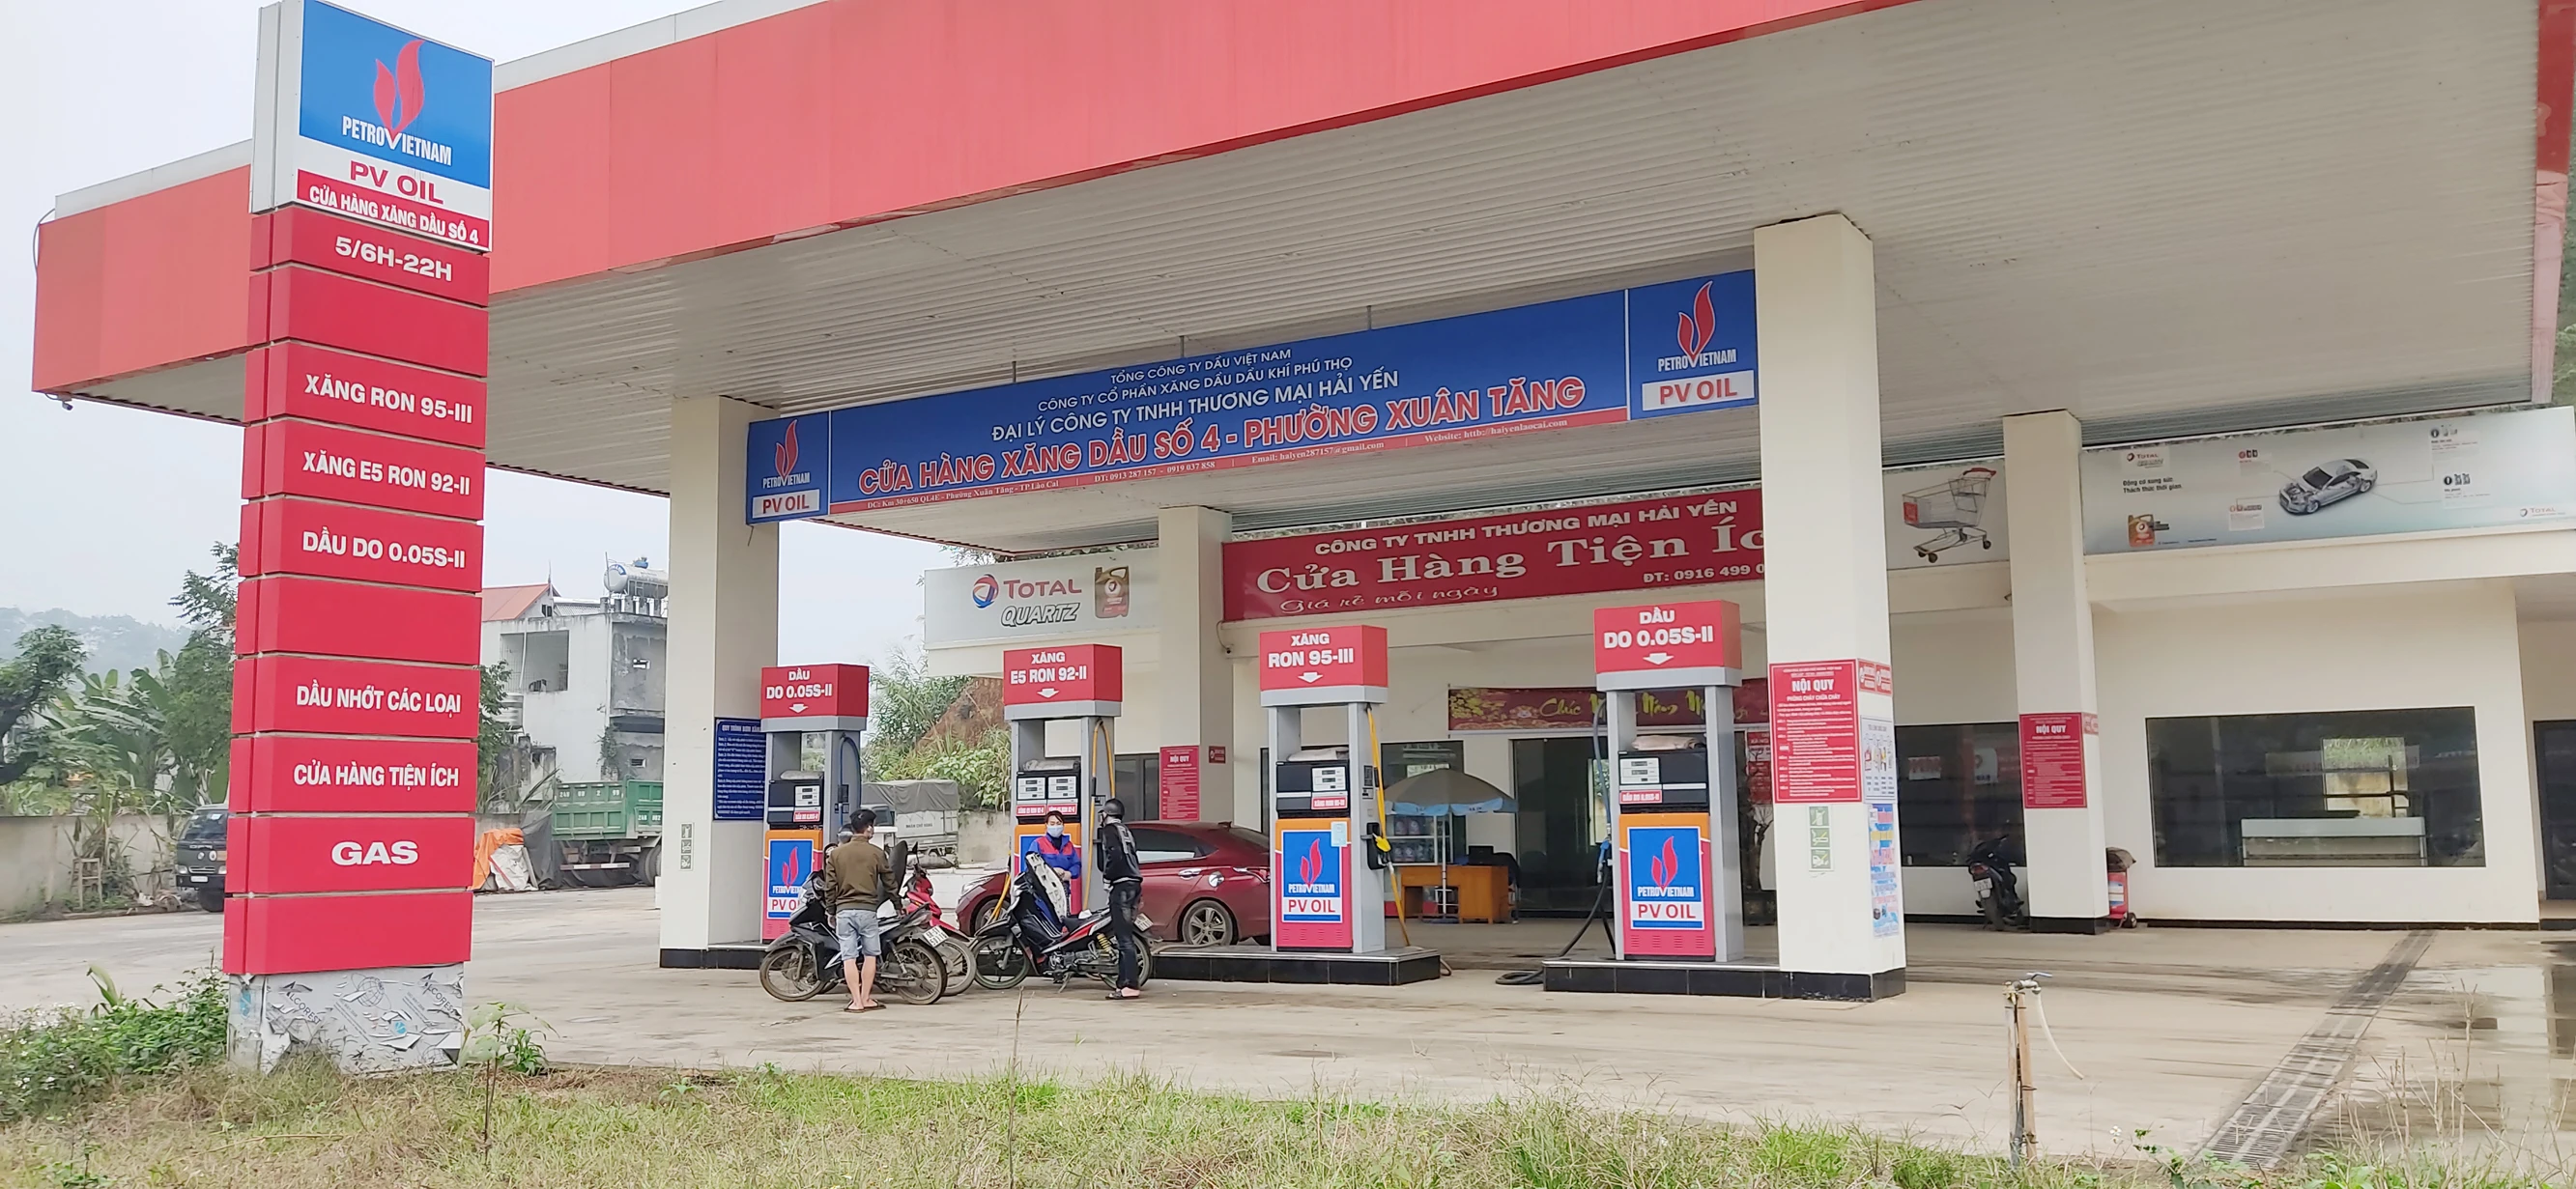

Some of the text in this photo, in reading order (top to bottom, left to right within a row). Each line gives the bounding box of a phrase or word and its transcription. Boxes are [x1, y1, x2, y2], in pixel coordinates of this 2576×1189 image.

[342, 115, 452, 166] PETROVIETNAM
[350, 160, 444, 205] PV OIL
[309, 184, 479, 243] CỬA HÀNG XĂNG DẦU SỐ 4
[335, 237, 453, 282] 5/6H-22H
[1111, 349, 1291, 384] TỔNG CÔNG TY DẦU VIỆT NAM
[1658, 349, 1736, 372] PETROVIETNAM
[1038, 356, 1353, 411] CÔNG TY CỔ PHẦN XĂNG DẦU DẦU KHÍ PHÚ THỌ
[1660, 378, 1737, 405] PV OIL
[304, 373, 473, 424] XĂNG RON 95-III
[991, 366, 1398, 444] ĐẠI LÝ CÔNG TY TNHH THƯƠNG MẠI HẢI YẾN
[859, 459, 913, 495] CỬA
[920, 452, 995, 488] HÀNG
[1001, 442, 1082, 478] XĂNG
[1089, 426, 1148, 467] DẦU
[1154, 417, 1194, 459] SỐ
[1200, 425, 1220, 452] 4
[1245, 402, 1378, 449] PHƯỜNG
[1386, 387, 1479, 432] XUÂN
[1487, 375, 1586, 415] TĂNG
[1424, 433, 1462, 442] Website:
[1251, 455, 1277, 464] Email:
[302, 449, 471, 496] XĂNG E5 RON 92-II
[762, 472, 811, 489] PETROVIETNAM
[1110, 472, 1127, 481] 0913
[1166, 465, 1185, 473] 0919
[762, 494, 810, 514] PV OIL
[1315, 498, 1737, 555] CÔNG TY TNHH THƯƠNG MẠI HẢI YẾN
[302, 526, 466, 569] DẦU DO 0.05S-II
[1256, 563, 1360, 594] Cửa
[1377, 552, 1526, 585] Hàng
[1547, 535, 1690, 567] Tiện
[1644, 572, 1670, 583] ĐT:
[1674, 567, 1715, 580] 0916
[1719, 564, 1752, 577] 499
[1003, 579, 1082, 600] TOTAL
[1432, 585, 1499, 602] ngày
[1000, 602, 1080, 627] QUARTZ
[1639, 607, 1675, 625] DẦU
[1291, 633, 1331, 647] XĂNG
[1604, 625, 1714, 649] DO 0.05S-II
[1031, 651, 1066, 665] XĂNG
[1268, 648, 1354, 668] RON 95-III
[788, 667, 811, 681] DẦU
[1011, 665, 1087, 685] E5 RON 92-II
[766, 683, 833, 699] DO 0.05S-II
[1791, 678, 1834, 694] NỘI QUY
[297, 679, 461, 719] DẦU NHỚT CÁC LOẠI
[1539, 697, 1582, 716] Chúc
[2036, 724, 2066, 734] NỘI QUY
[294, 759, 459, 791] CỬA HÀNG TIỆN ÍCH
[331, 840, 419, 866] GAS
[772, 899, 787, 910] PV
[1288, 898, 1335, 913] PV OIL
[1638, 904, 1696, 919] PV OIL
